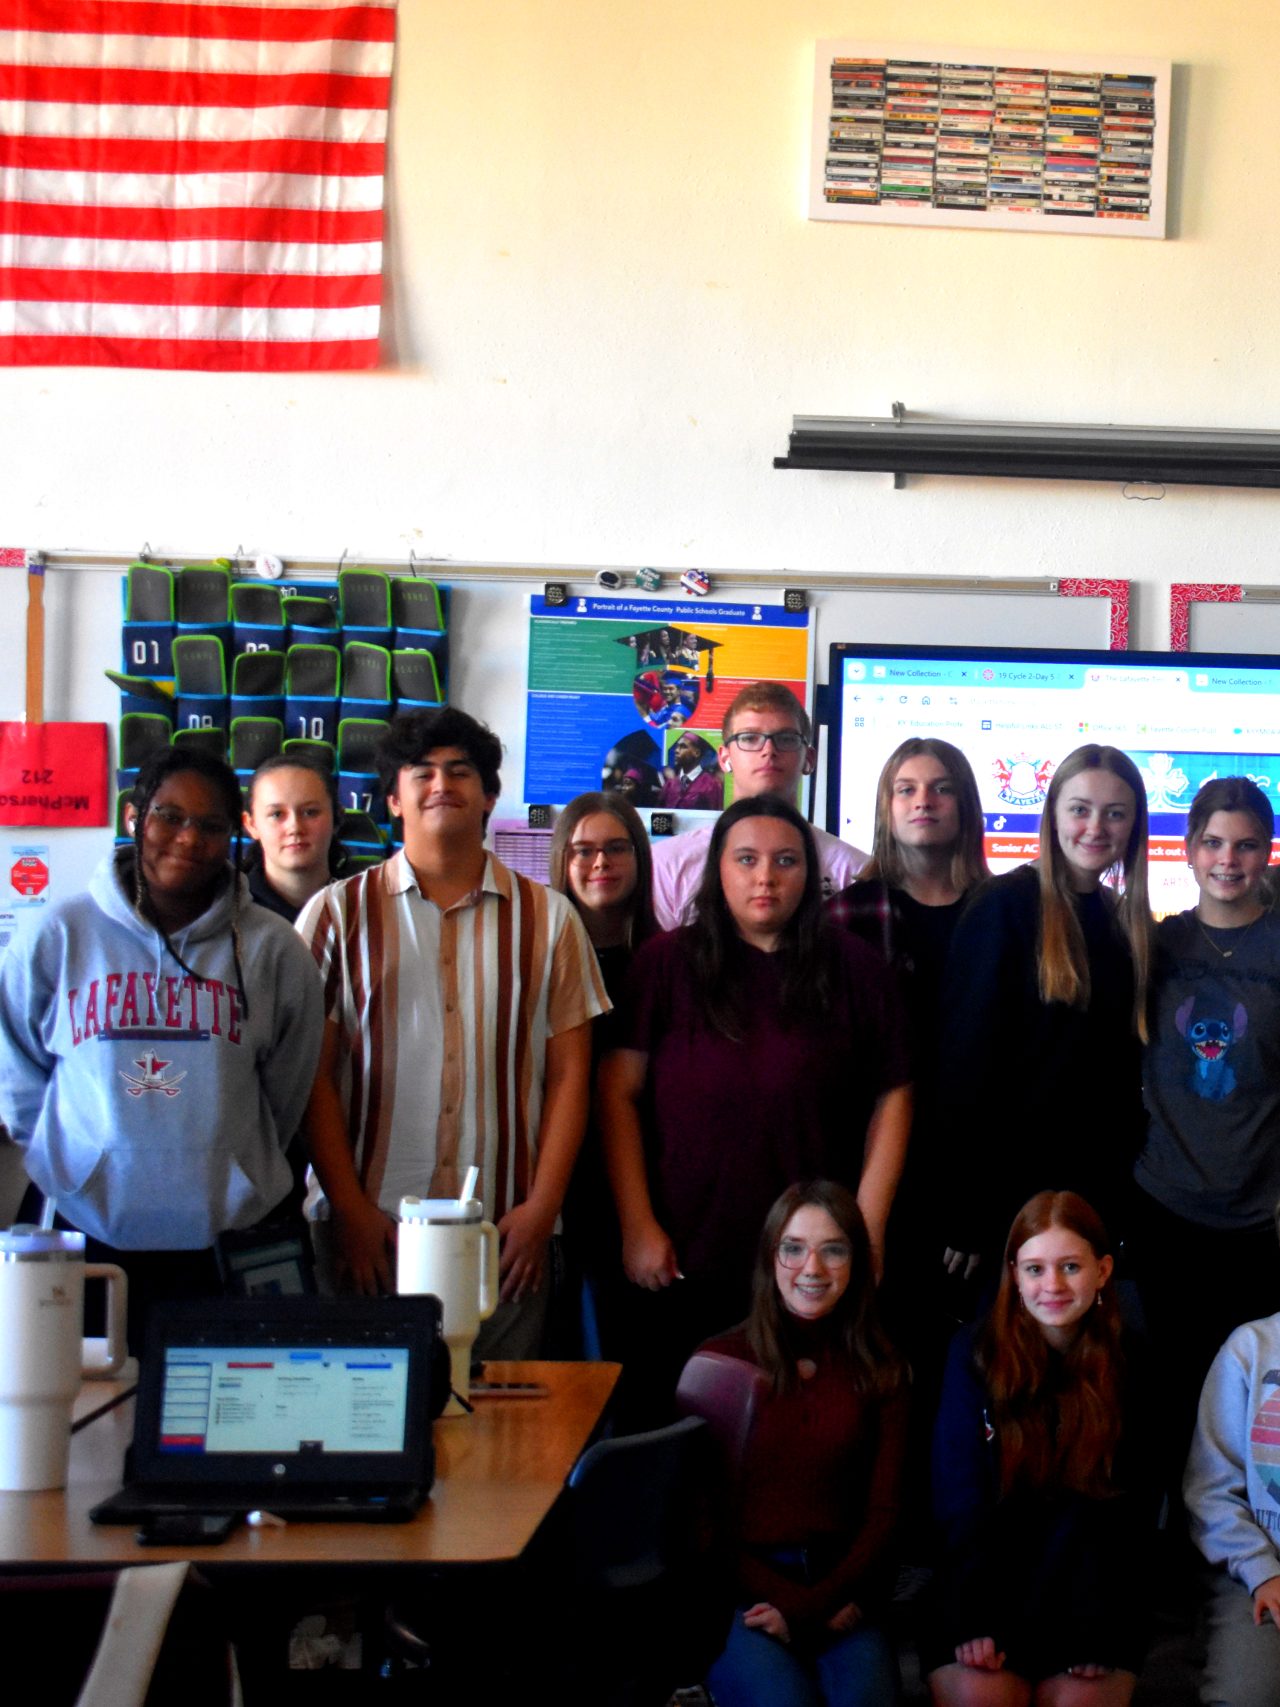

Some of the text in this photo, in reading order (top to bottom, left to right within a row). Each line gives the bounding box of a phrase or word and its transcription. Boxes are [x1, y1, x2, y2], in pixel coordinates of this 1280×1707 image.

[675, 606, 694, 614] Public
[695, 607, 718, 615] Schools
[132, 640, 160, 665] 01
[889, 669, 942, 678] New Collection
[1008, 672, 1026, 682] Cycle
[1027, 672, 1049, 682] 2-Day
[1211, 678, 1262, 687] New Collection
[300, 716, 324, 741] 10
[21, 769, 54, 785] 212
[350, 791, 373, 812] 17
[992, 843, 1022, 854] Senior
[67, 971, 245, 1047] LAFAYETTE
